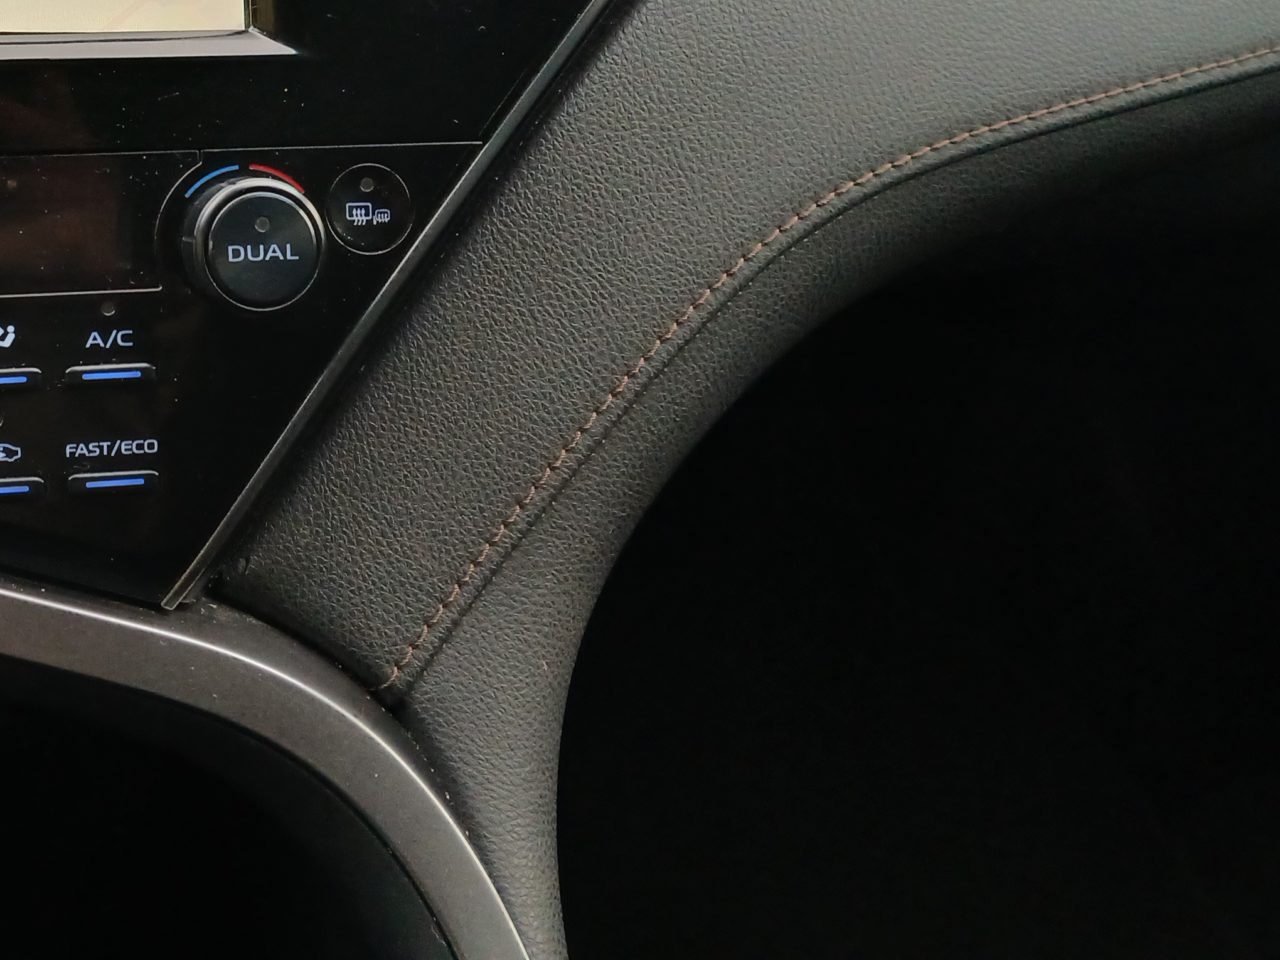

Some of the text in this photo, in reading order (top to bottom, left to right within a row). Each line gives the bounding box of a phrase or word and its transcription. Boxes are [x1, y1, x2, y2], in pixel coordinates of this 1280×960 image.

[228, 244, 299, 262] DUAL
[86, 330, 133, 348] A/C
[65, 438, 158, 457] FAST/ECO
